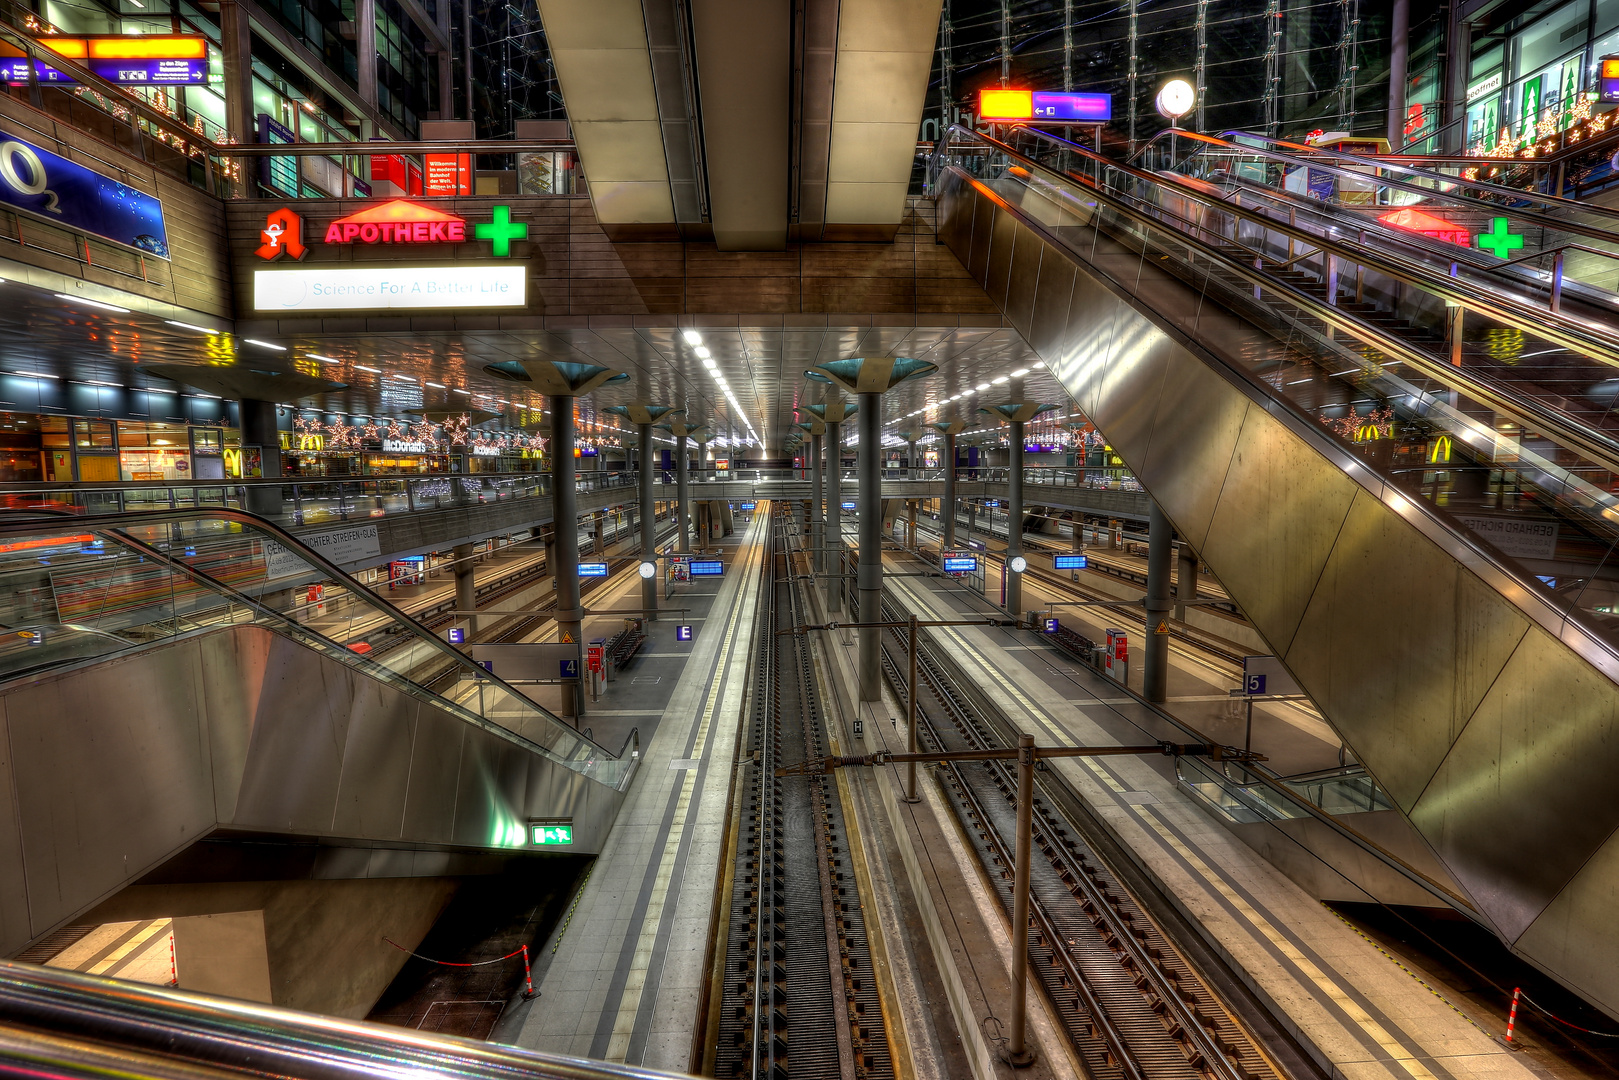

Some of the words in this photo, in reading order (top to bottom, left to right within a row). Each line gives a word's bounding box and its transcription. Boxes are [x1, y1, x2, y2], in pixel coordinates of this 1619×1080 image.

[324, 222, 466, 243] APOTHEKE
[313, 282, 375, 296] Science
[380, 281, 406, 294] For
[411, 282, 421, 293] A
[427, 280, 473, 294] Better
[480, 280, 509, 293] Life
[383, 439, 426, 453] McDonald's
[682, 626, 691, 638] E
[1046, 619, 1054, 631] E
[449, 628, 459, 641] E
[566, 660, 576, 674] 4
[1249, 675, 1260, 691] 5
[854, 722, 862, 732] H
